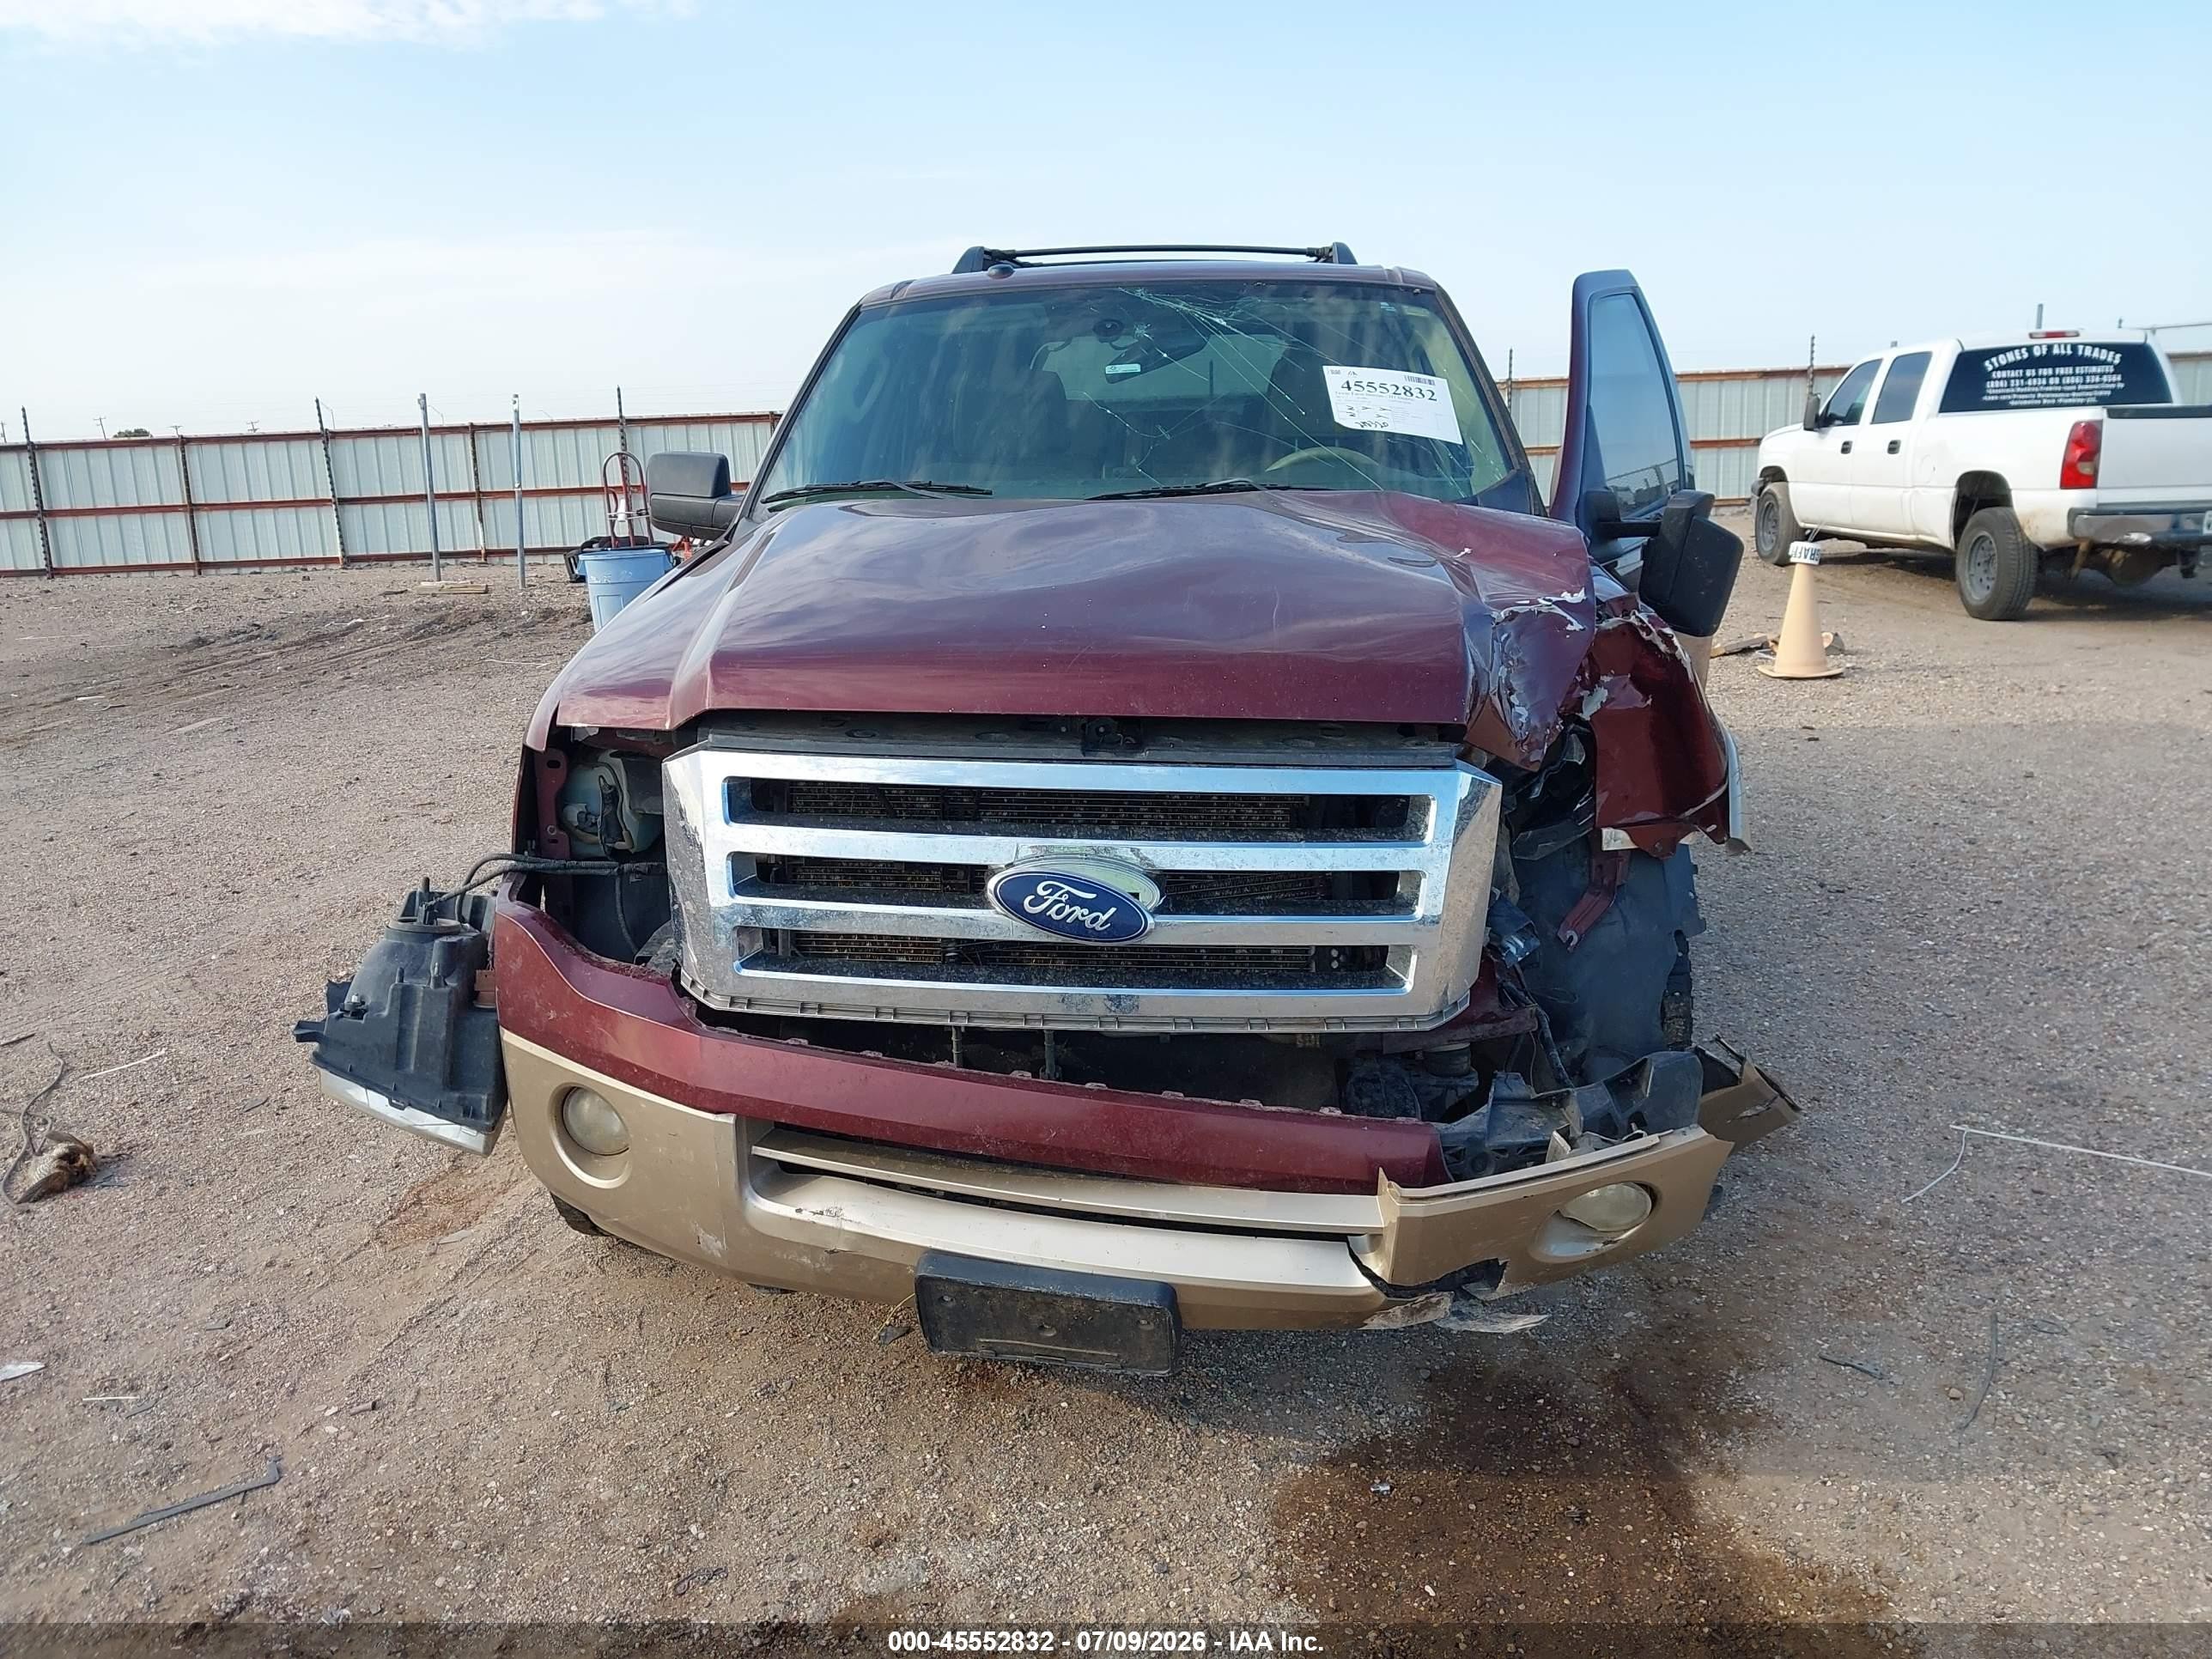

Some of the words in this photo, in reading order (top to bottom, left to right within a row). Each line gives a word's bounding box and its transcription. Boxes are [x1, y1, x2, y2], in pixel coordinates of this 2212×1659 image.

[1984, 347, 2028, 372] STONES
[2033, 344, 2048, 357] OF
[2052, 343, 2073, 356] ALL
[2077, 344, 2122, 365] TRADES
[1991, 369, 2023, 379] CONTACT
[2026, 368, 2036, 378] US
[2038, 368, 2053, 376] FOR
[2055, 367, 2074, 376] FREE
[2075, 365, 2115, 374] ESTIMATES
[1340, 379, 1437, 402] 45552832
[1023, 880, 1117, 931] Ford
